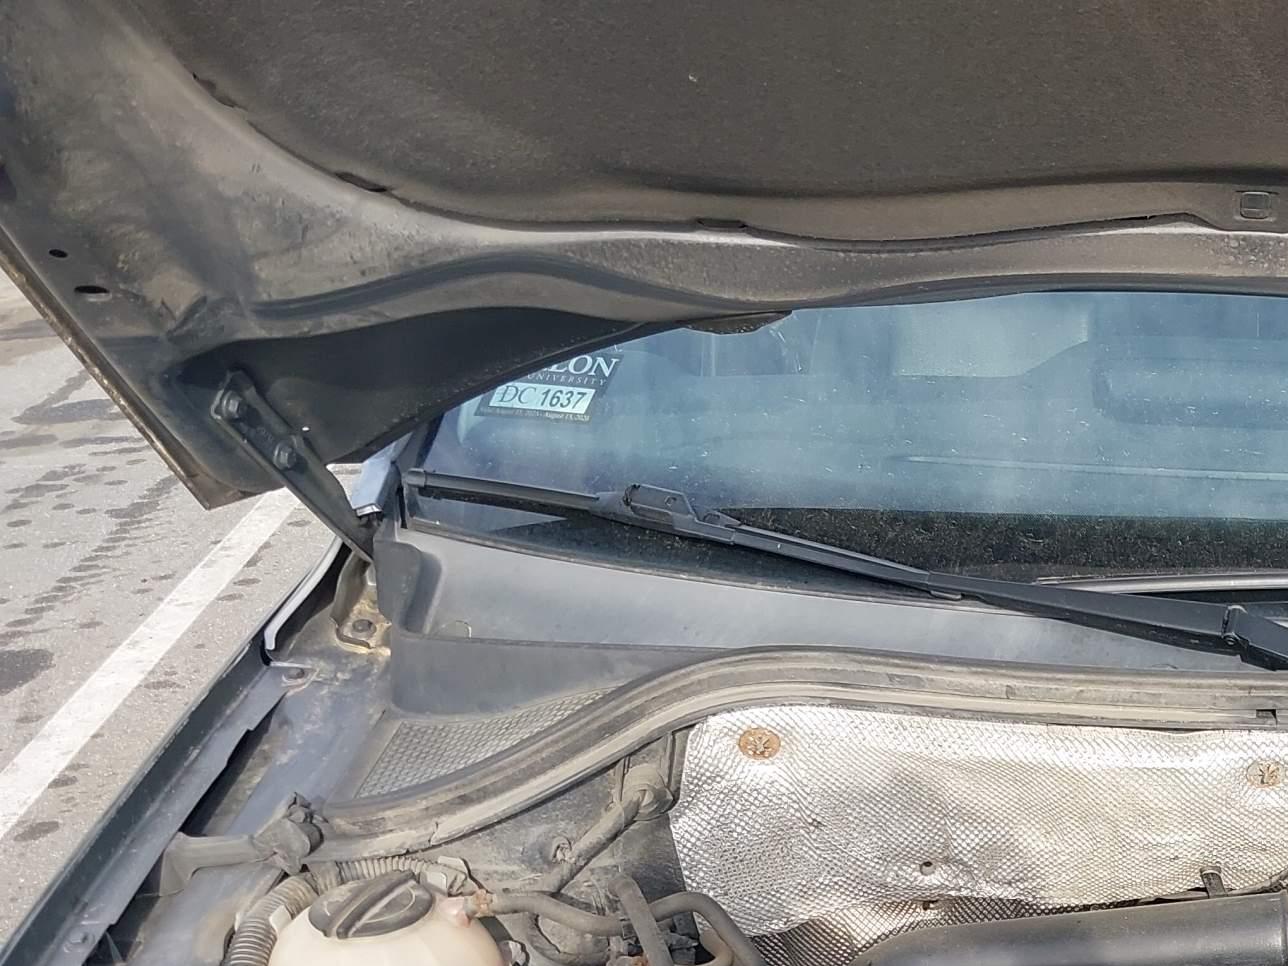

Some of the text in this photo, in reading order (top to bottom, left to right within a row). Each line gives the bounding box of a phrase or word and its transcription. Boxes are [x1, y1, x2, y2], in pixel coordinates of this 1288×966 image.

[527, 373, 607, 386] UNIVERSITY
[499, 385, 588, 409] DC 1637
